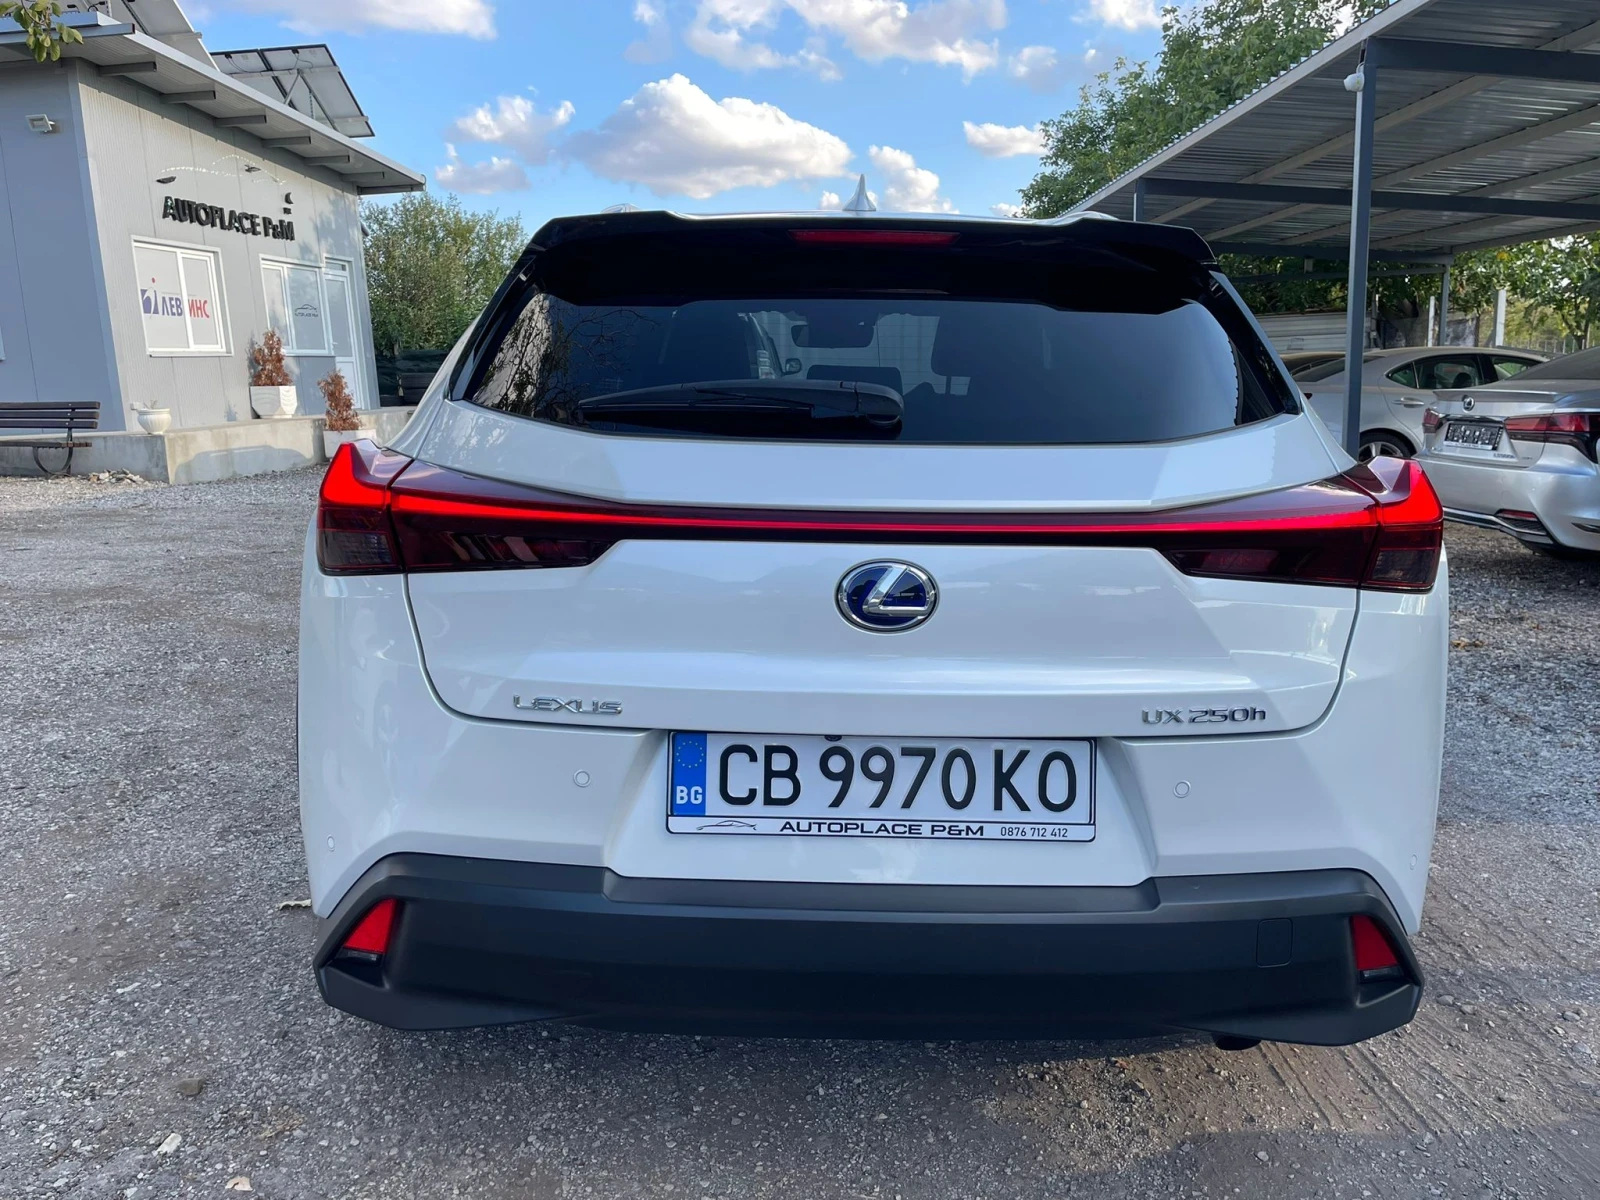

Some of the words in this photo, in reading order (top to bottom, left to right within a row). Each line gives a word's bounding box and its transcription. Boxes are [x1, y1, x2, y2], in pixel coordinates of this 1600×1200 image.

[162, 196, 261, 236] AUTOPLACE
[262, 216, 295, 241] P&M
[162, 296, 183, 317] ЛЕВ
[188, 299, 210, 318] ИНС
[513, 694, 622, 714] LEXUS
[1141, 708, 1184, 724] UX
[1188, 706, 1266, 723] 250h
[719, 744, 800, 806] CB
[819, 746, 976, 810] 9970
[994, 750, 1077, 813] KO
[676, 785, 703, 804] BG
[780, 821, 922, 835] AUTOPLACE
[930, 825, 984, 837] P&M
[1000, 827, 1027, 837] 0876
[1030, 827, 1047, 838] 712
[1050, 828, 1068, 838] 412
